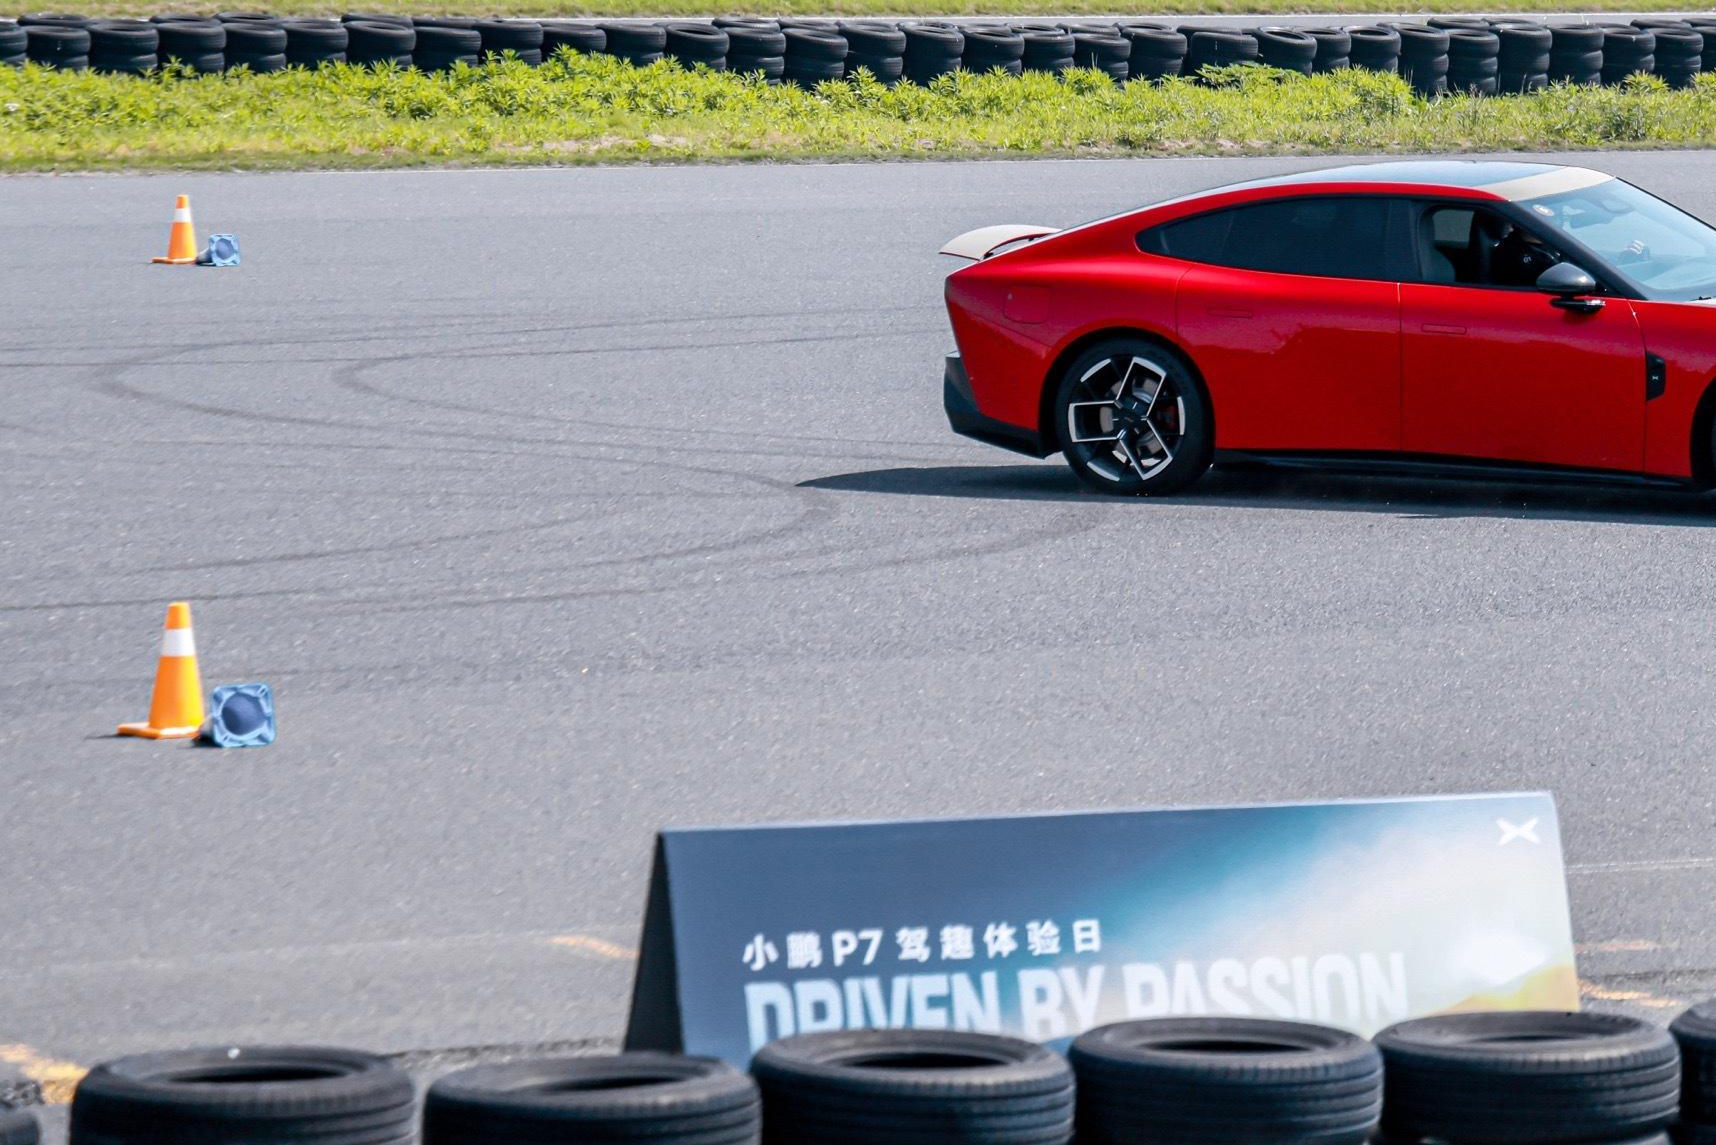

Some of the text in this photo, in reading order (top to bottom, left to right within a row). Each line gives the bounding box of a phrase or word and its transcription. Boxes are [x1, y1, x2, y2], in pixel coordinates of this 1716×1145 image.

[742, 919, 1101, 971] 小鹏 P7 驾趣体验日
[1017, 964, 1105, 1039] BY
